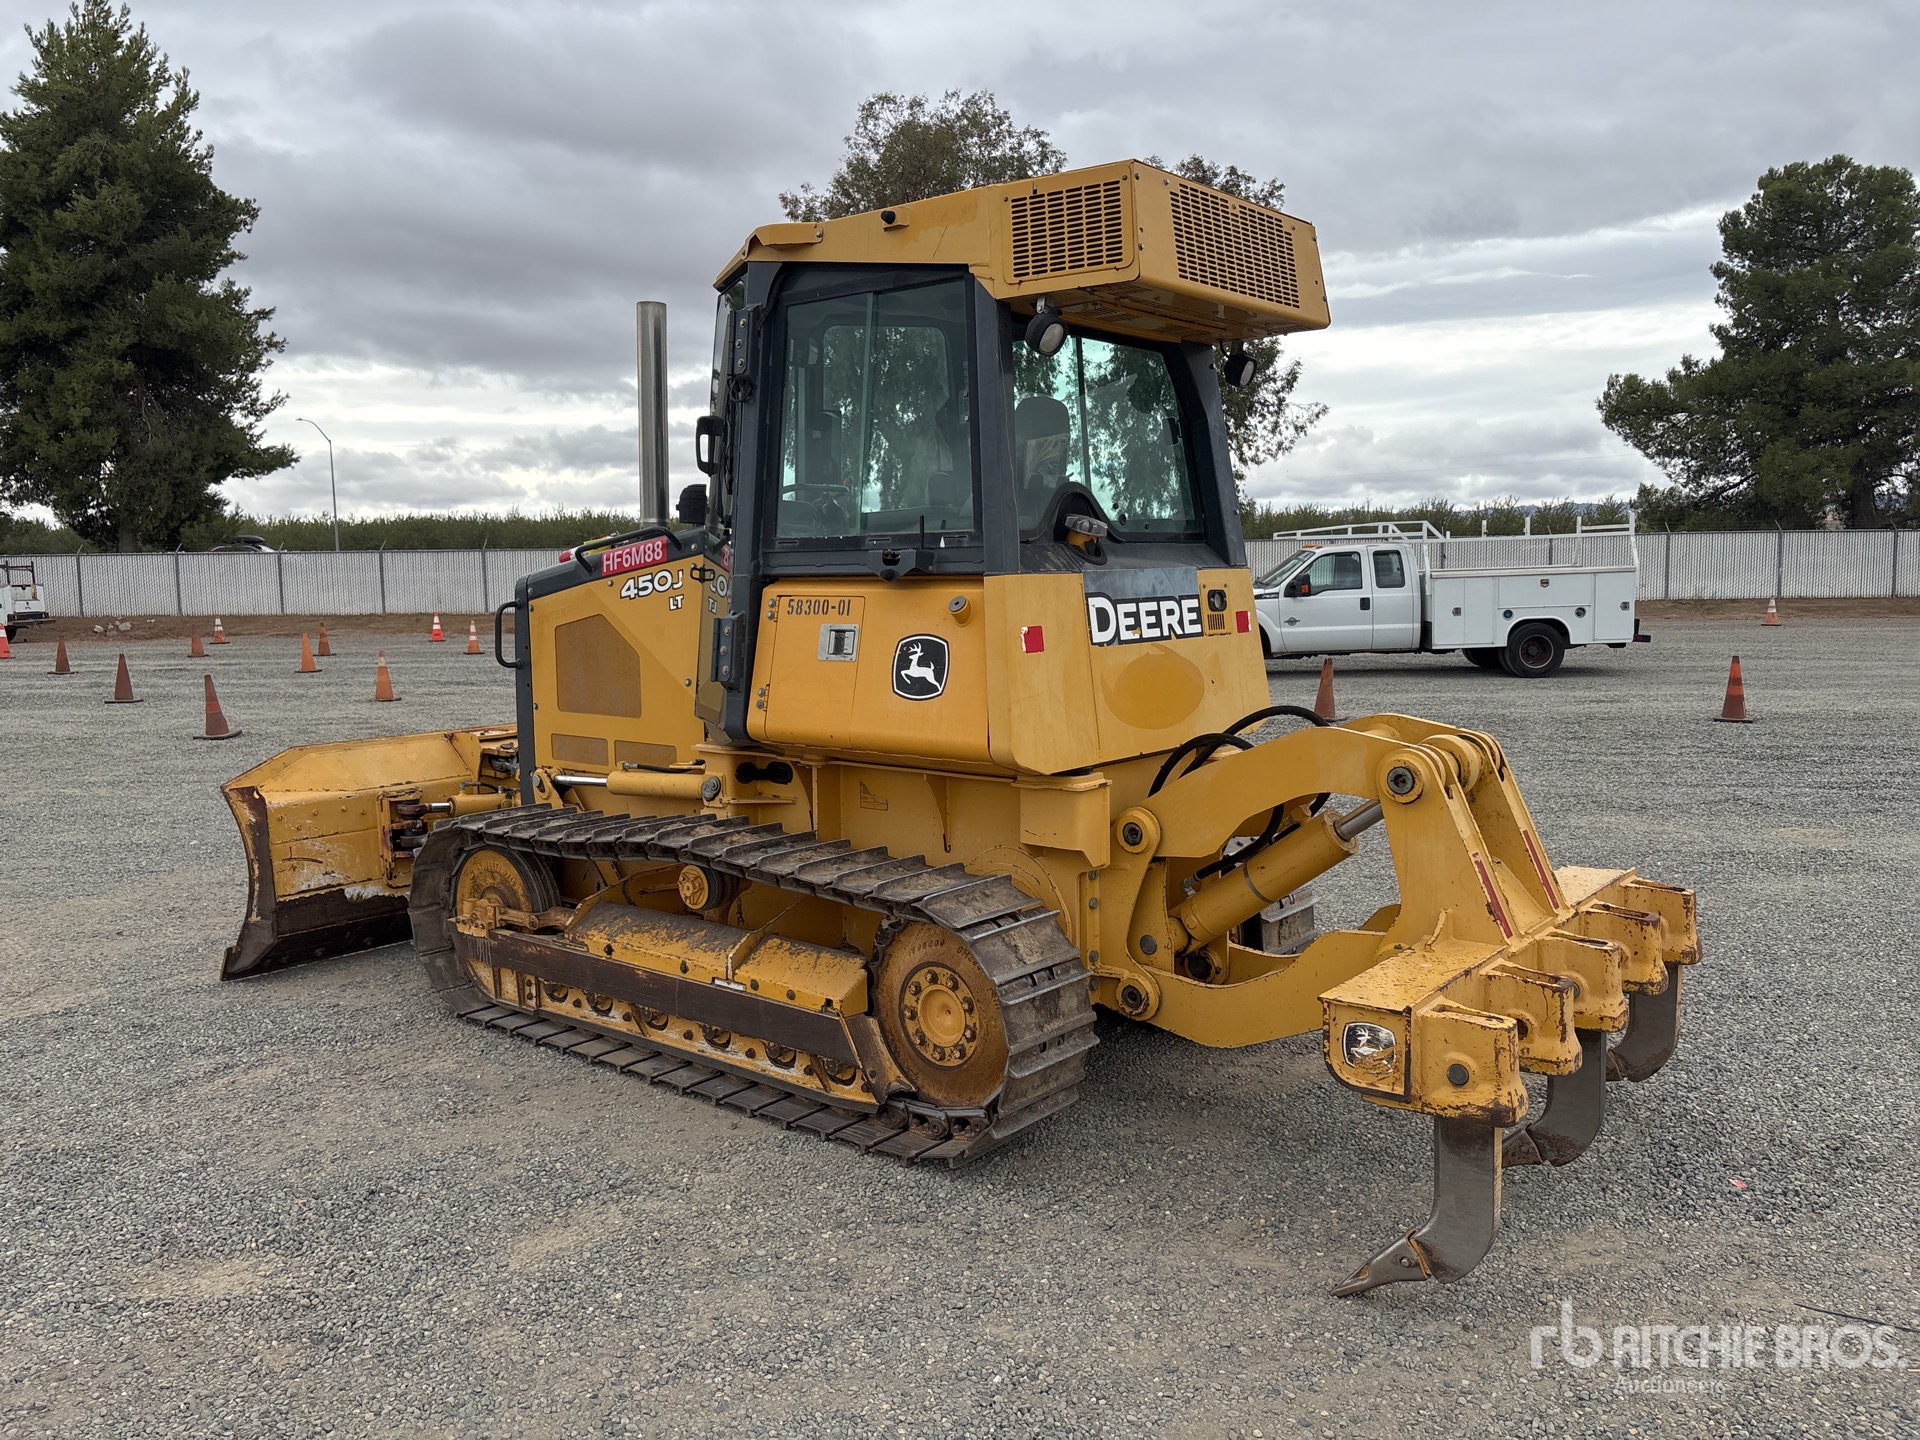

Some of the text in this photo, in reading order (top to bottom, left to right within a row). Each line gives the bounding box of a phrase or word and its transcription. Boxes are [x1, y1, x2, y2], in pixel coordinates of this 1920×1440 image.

[603, 540, 663, 573] HF6M88
[620, 569, 684, 600] 450J
[668, 594, 684, 611] LT
[786, 598, 852, 617] 58300-01
[1087, 596, 1202, 644] DEERE
